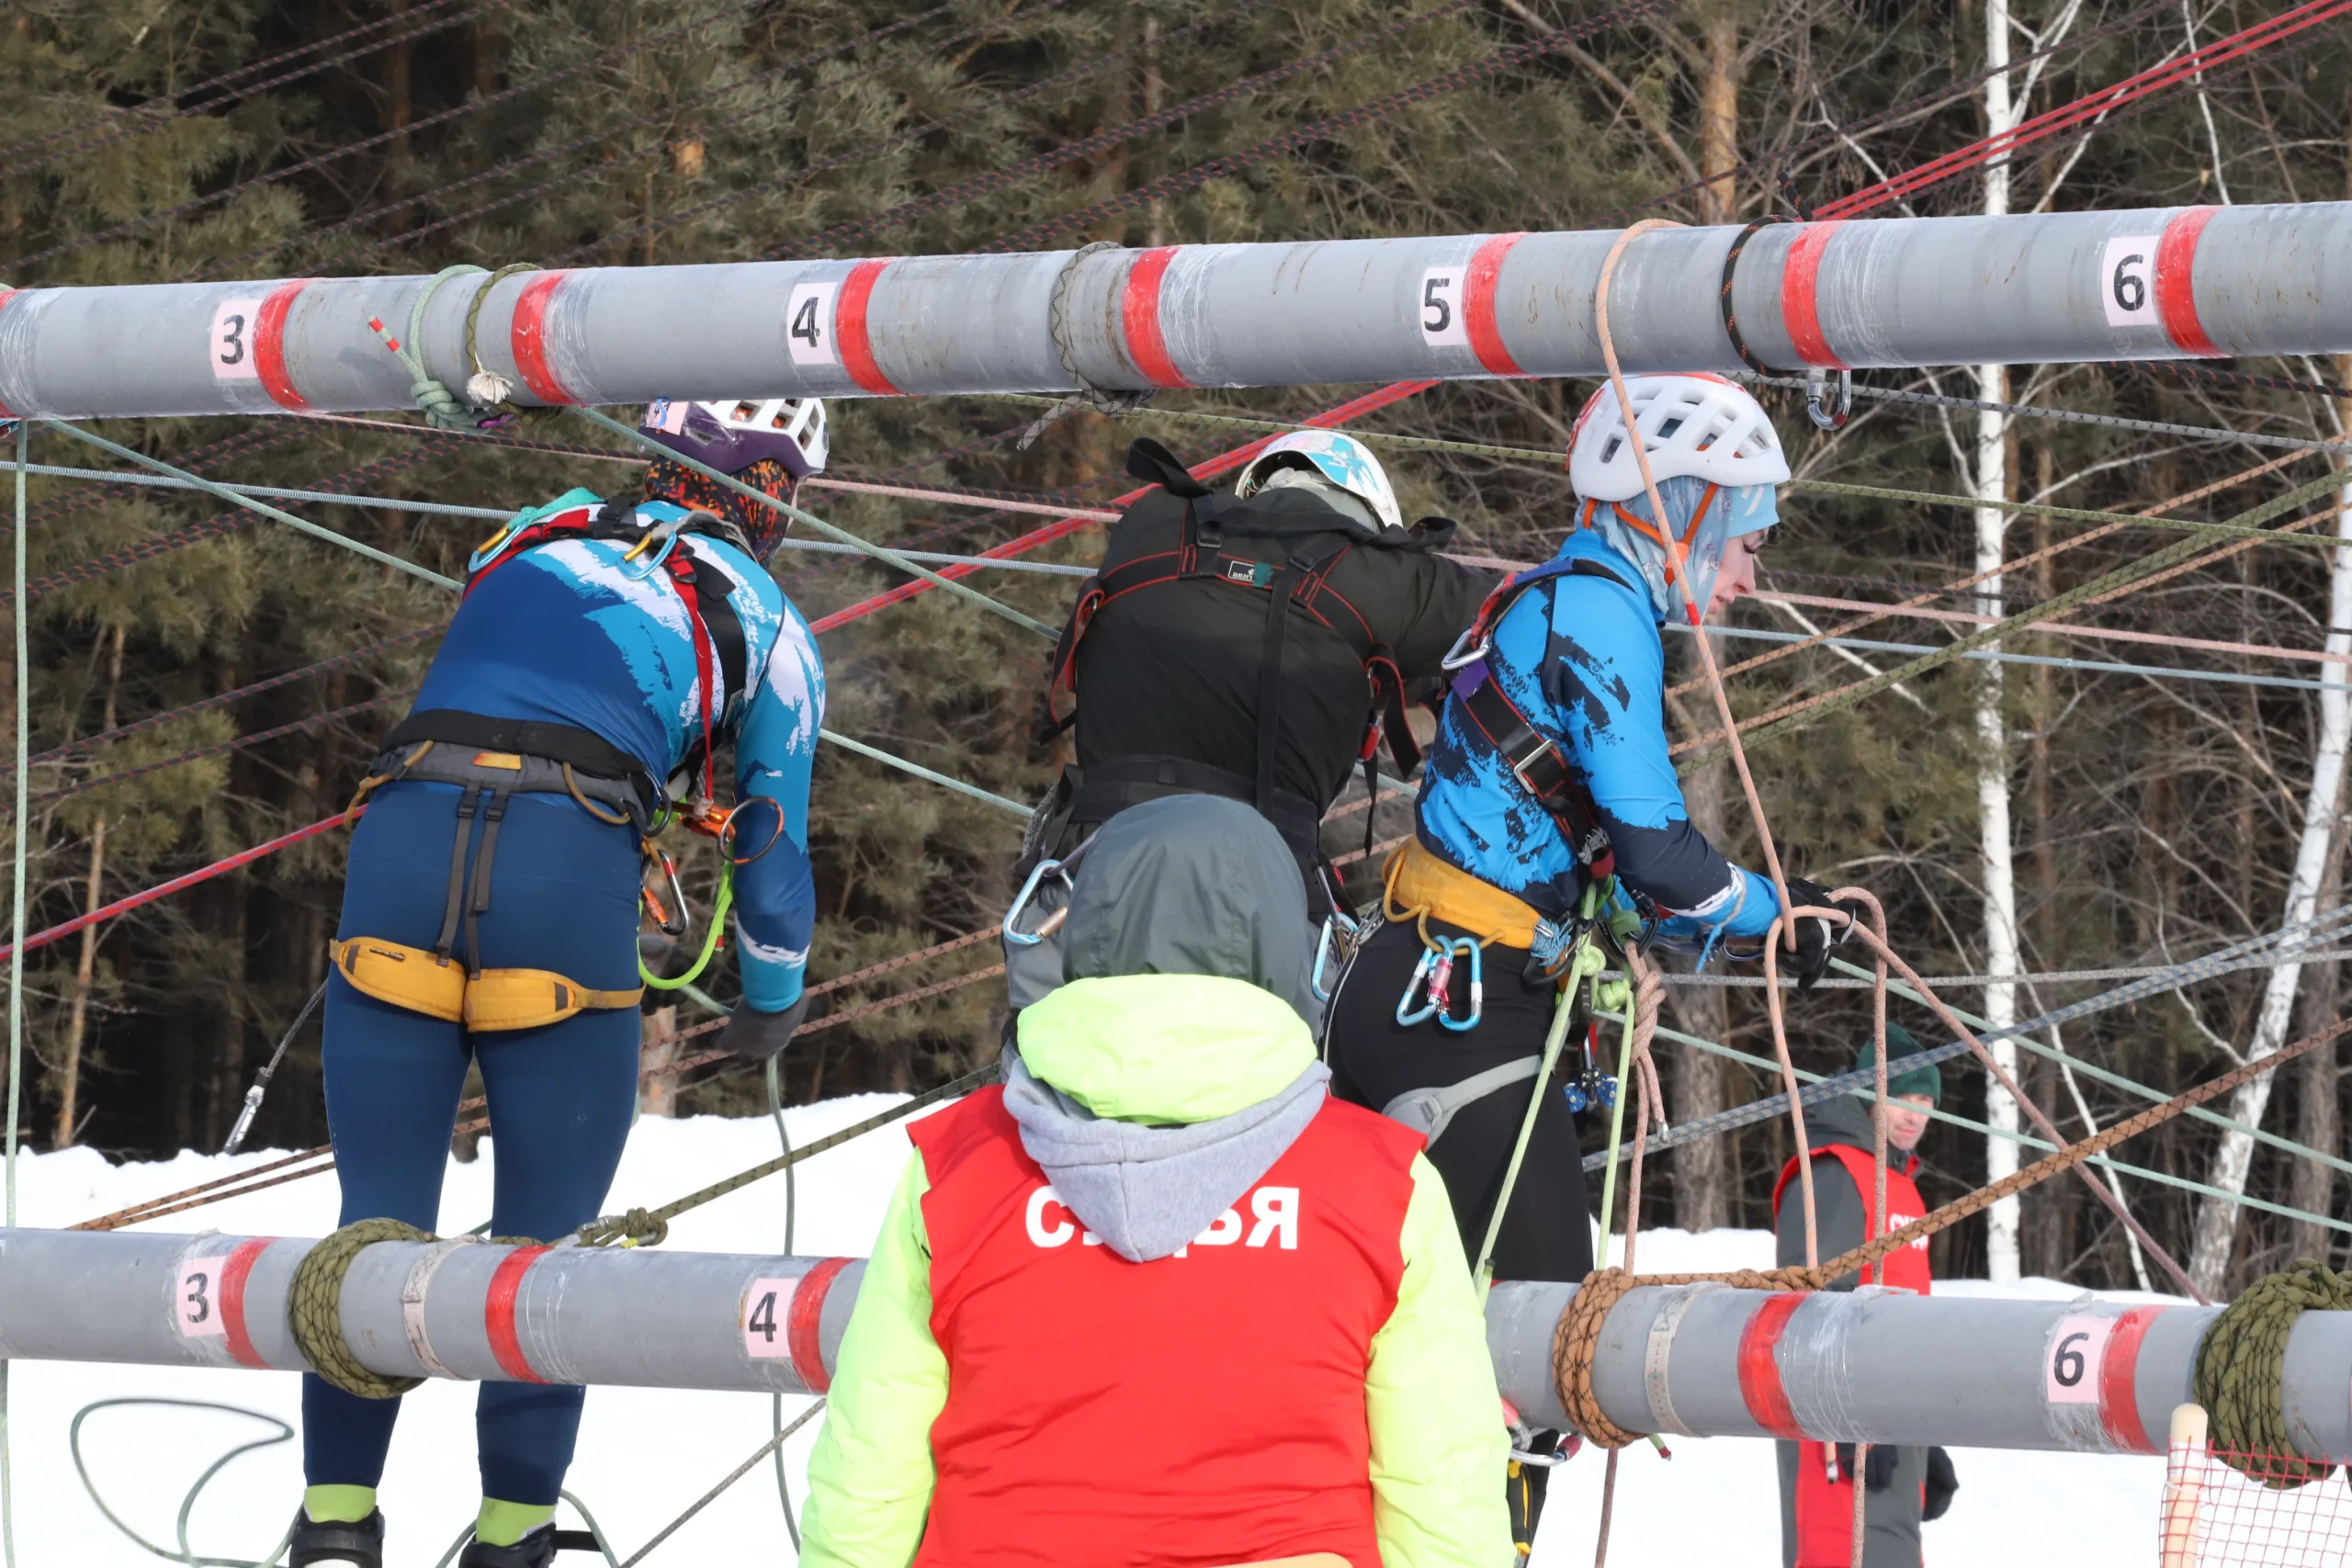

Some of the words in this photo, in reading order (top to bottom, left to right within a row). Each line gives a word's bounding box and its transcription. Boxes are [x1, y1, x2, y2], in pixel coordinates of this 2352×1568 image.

[1425, 277, 1451, 333] 5
[2113, 254, 2145, 312] 6
[220, 314, 244, 365] 3
[791, 296, 820, 348] 4
[1024, 1185, 1300, 1258] СЬЯ
[186, 1272, 210, 1324] 3
[748, 1292, 777, 1343] 4
[2053, 1332, 2090, 1388] 6
